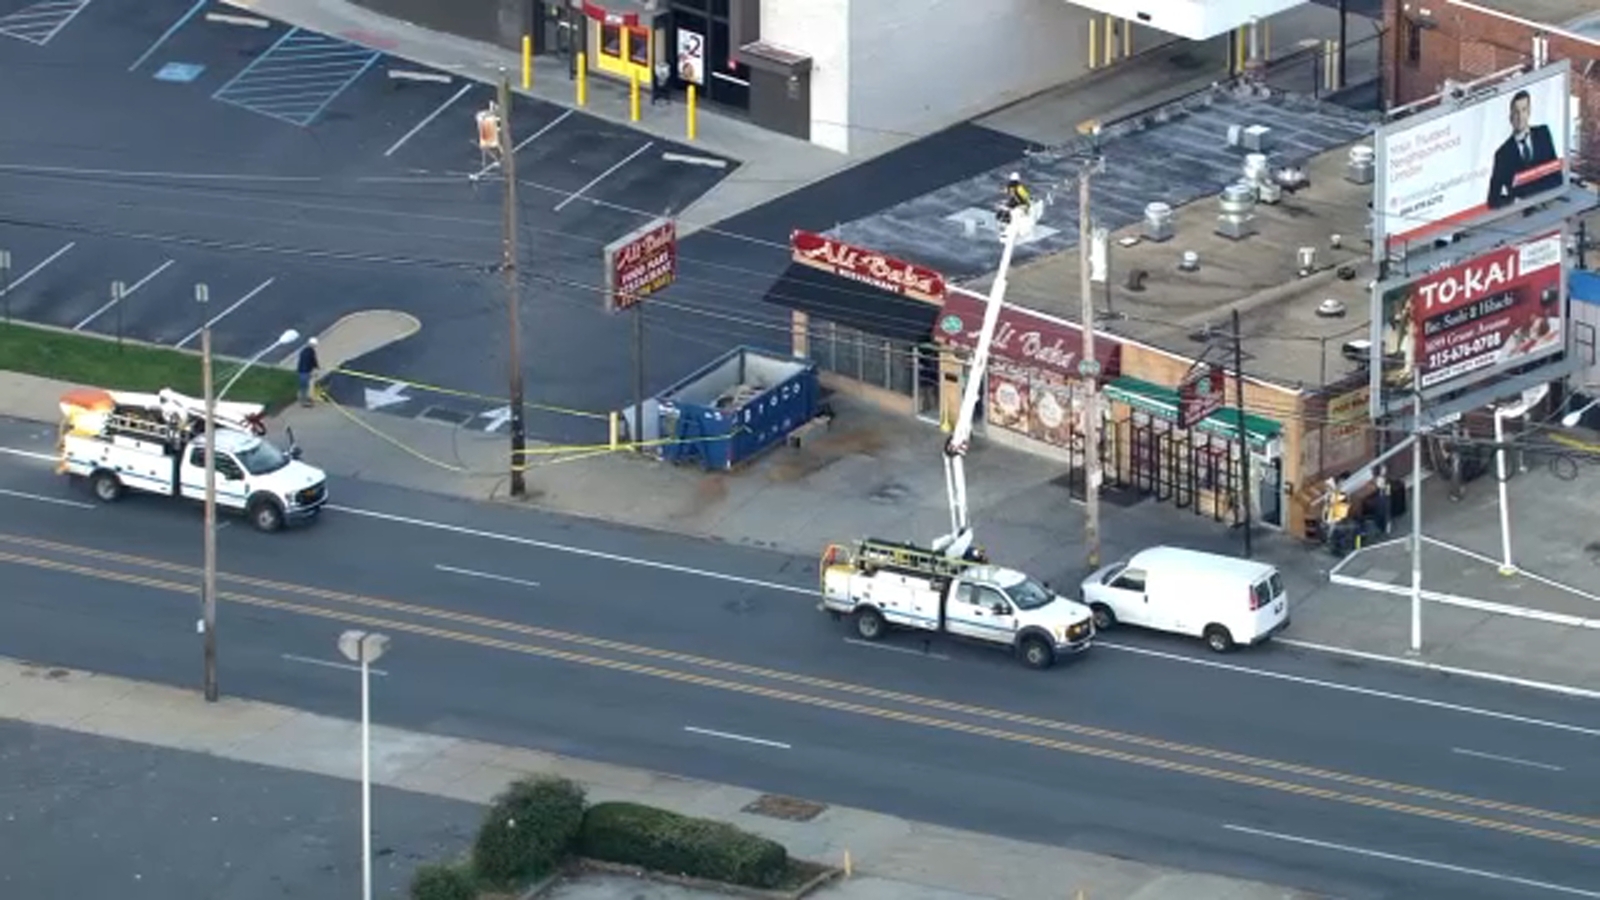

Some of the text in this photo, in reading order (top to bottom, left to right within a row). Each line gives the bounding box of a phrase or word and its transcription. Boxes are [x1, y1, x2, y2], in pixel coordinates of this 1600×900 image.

[803, 241, 932, 293] Ali Baba
[1418, 253, 1516, 310] TO-KAI
